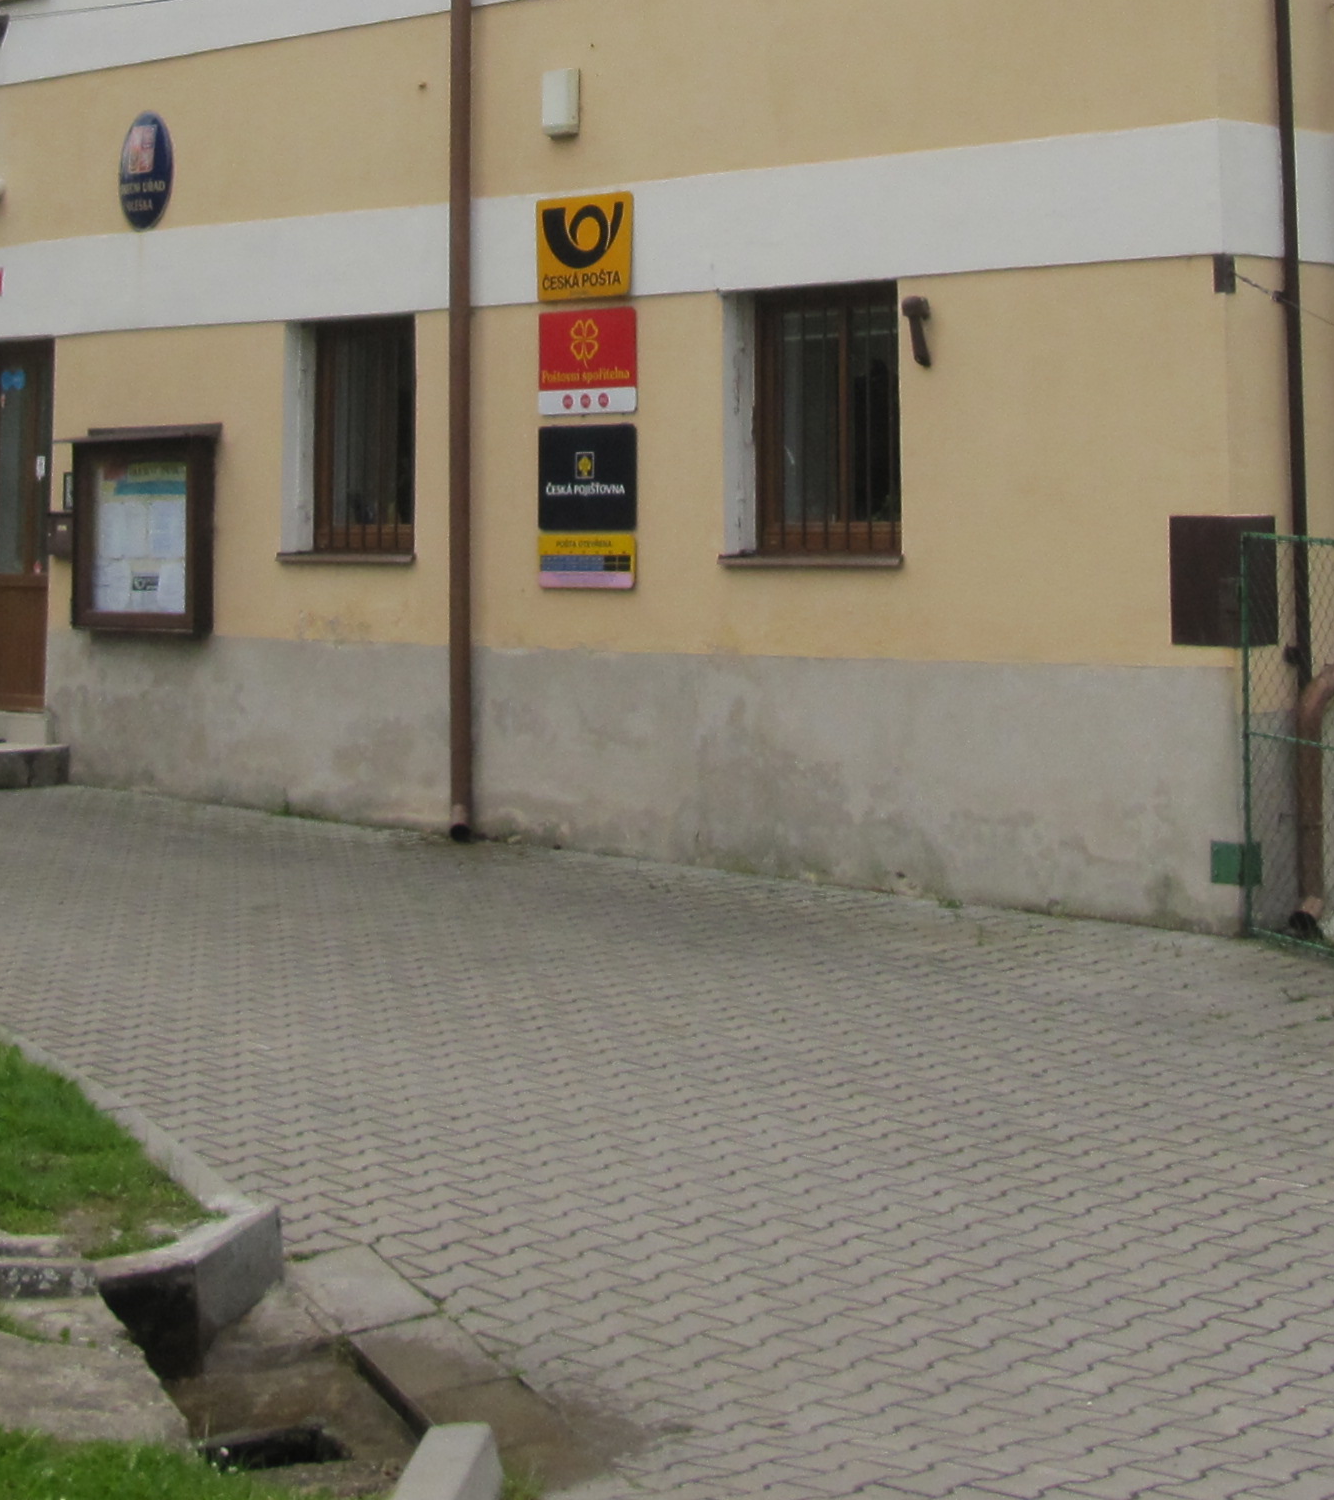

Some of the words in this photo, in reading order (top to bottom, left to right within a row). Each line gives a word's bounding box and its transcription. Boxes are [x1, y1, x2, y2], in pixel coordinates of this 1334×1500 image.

[542, 271, 579, 291] ČESKÁ
[582, 269, 621, 287] POŠTA
[542, 368, 580, 384] Poštovní
[582, 366, 630, 384] spořitelna
[546, 482, 573, 495] ČESKÁ
[574, 482, 625, 496] POJIŠŤOVNA
